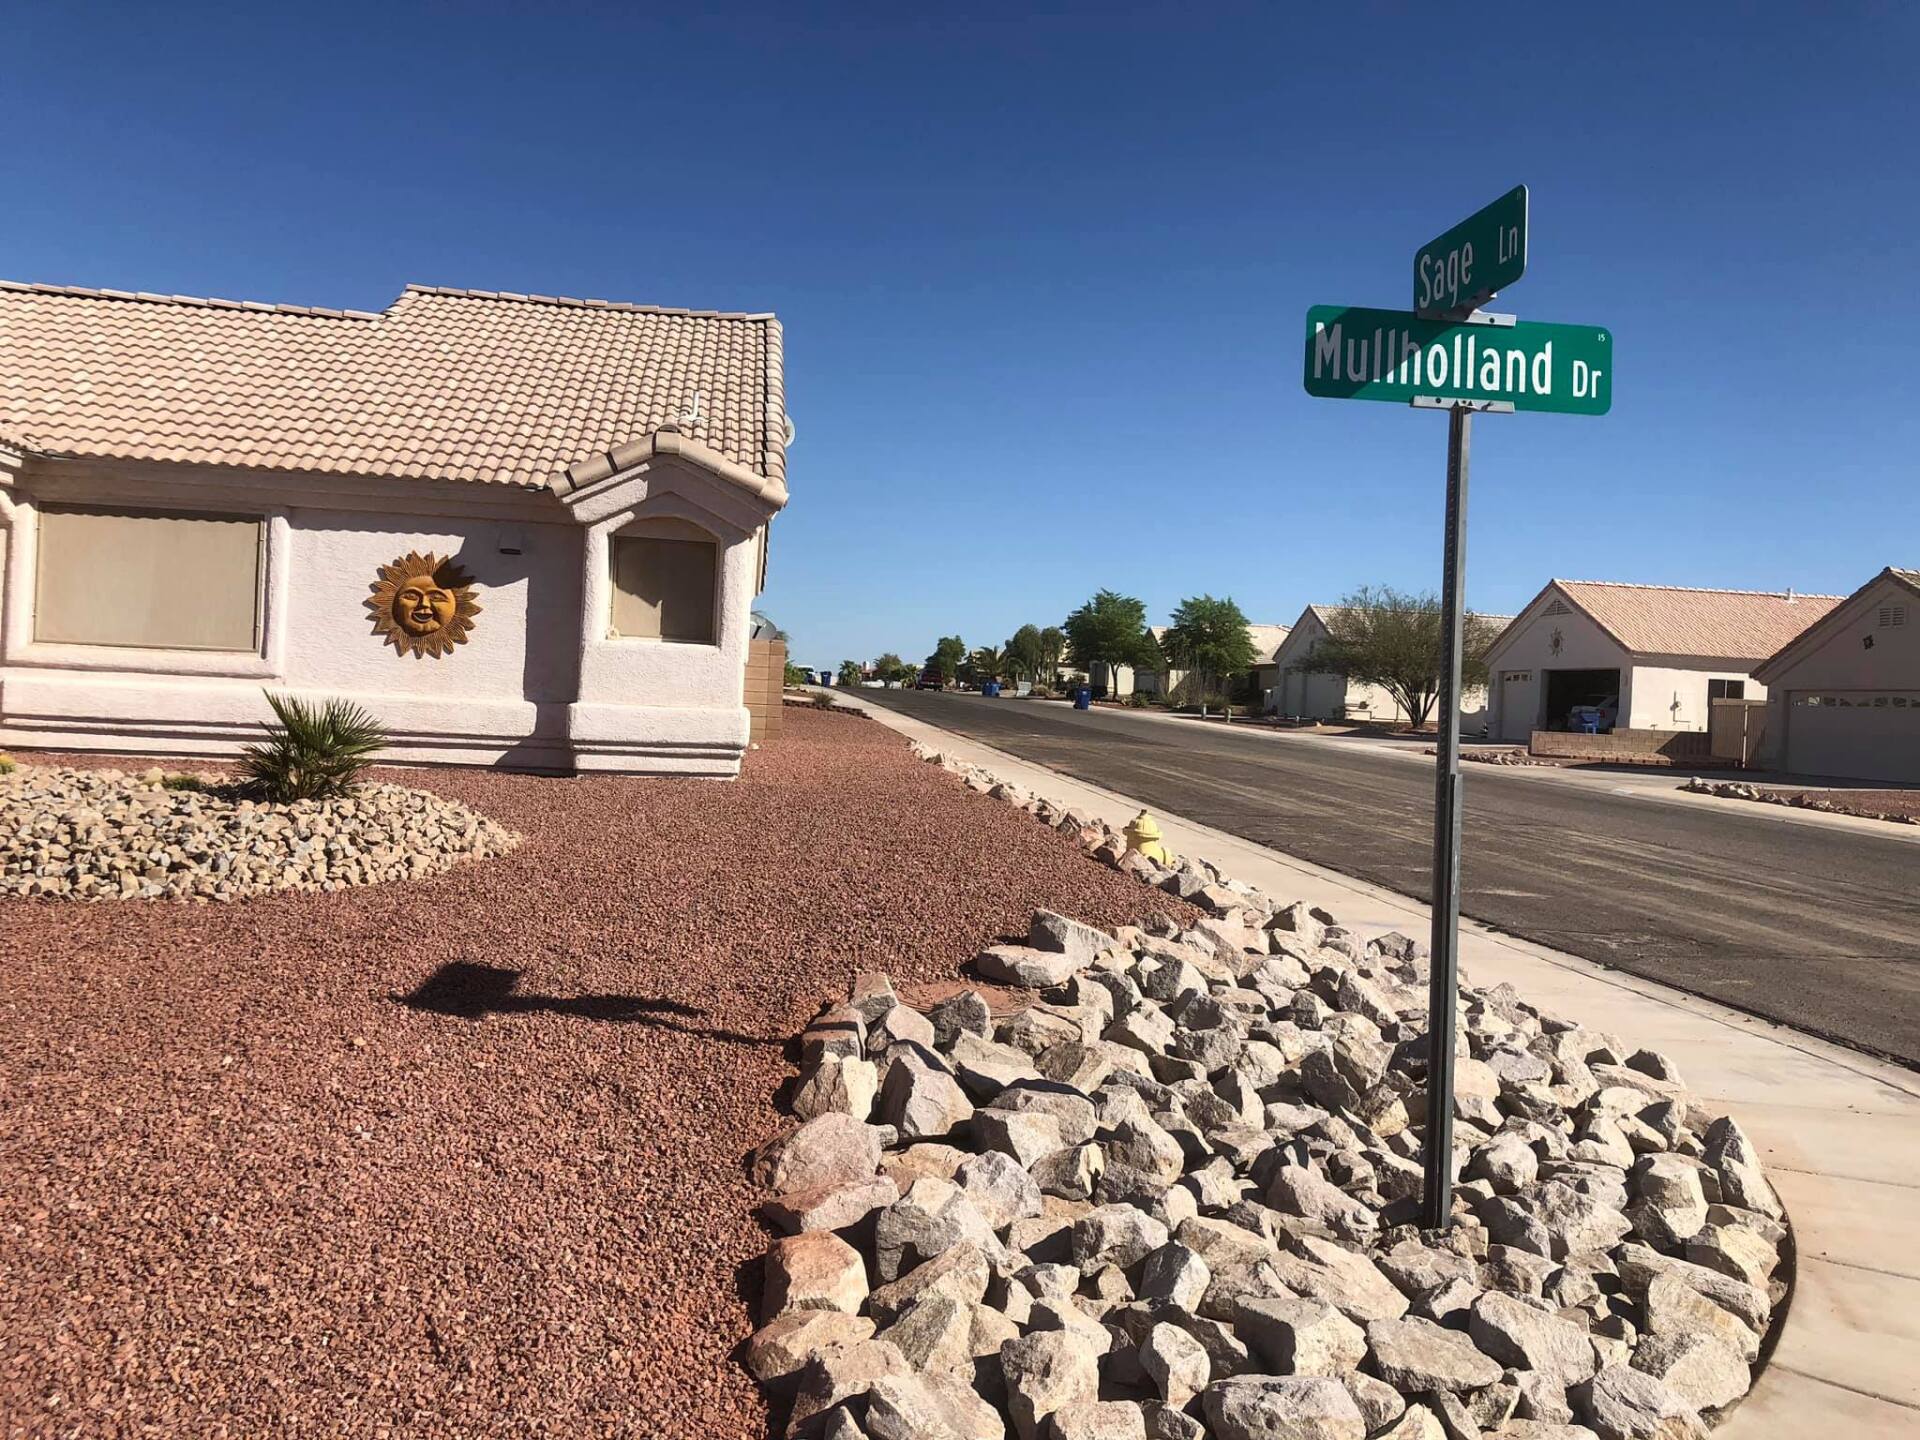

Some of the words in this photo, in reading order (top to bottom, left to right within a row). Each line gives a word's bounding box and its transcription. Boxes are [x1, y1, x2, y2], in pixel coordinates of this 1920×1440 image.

[1418, 242, 1473, 308] Sage
[1499, 226, 1518, 265] Ln
[1313, 322, 1552, 395] Mullholland
[1572, 360, 1602, 399] Dr
